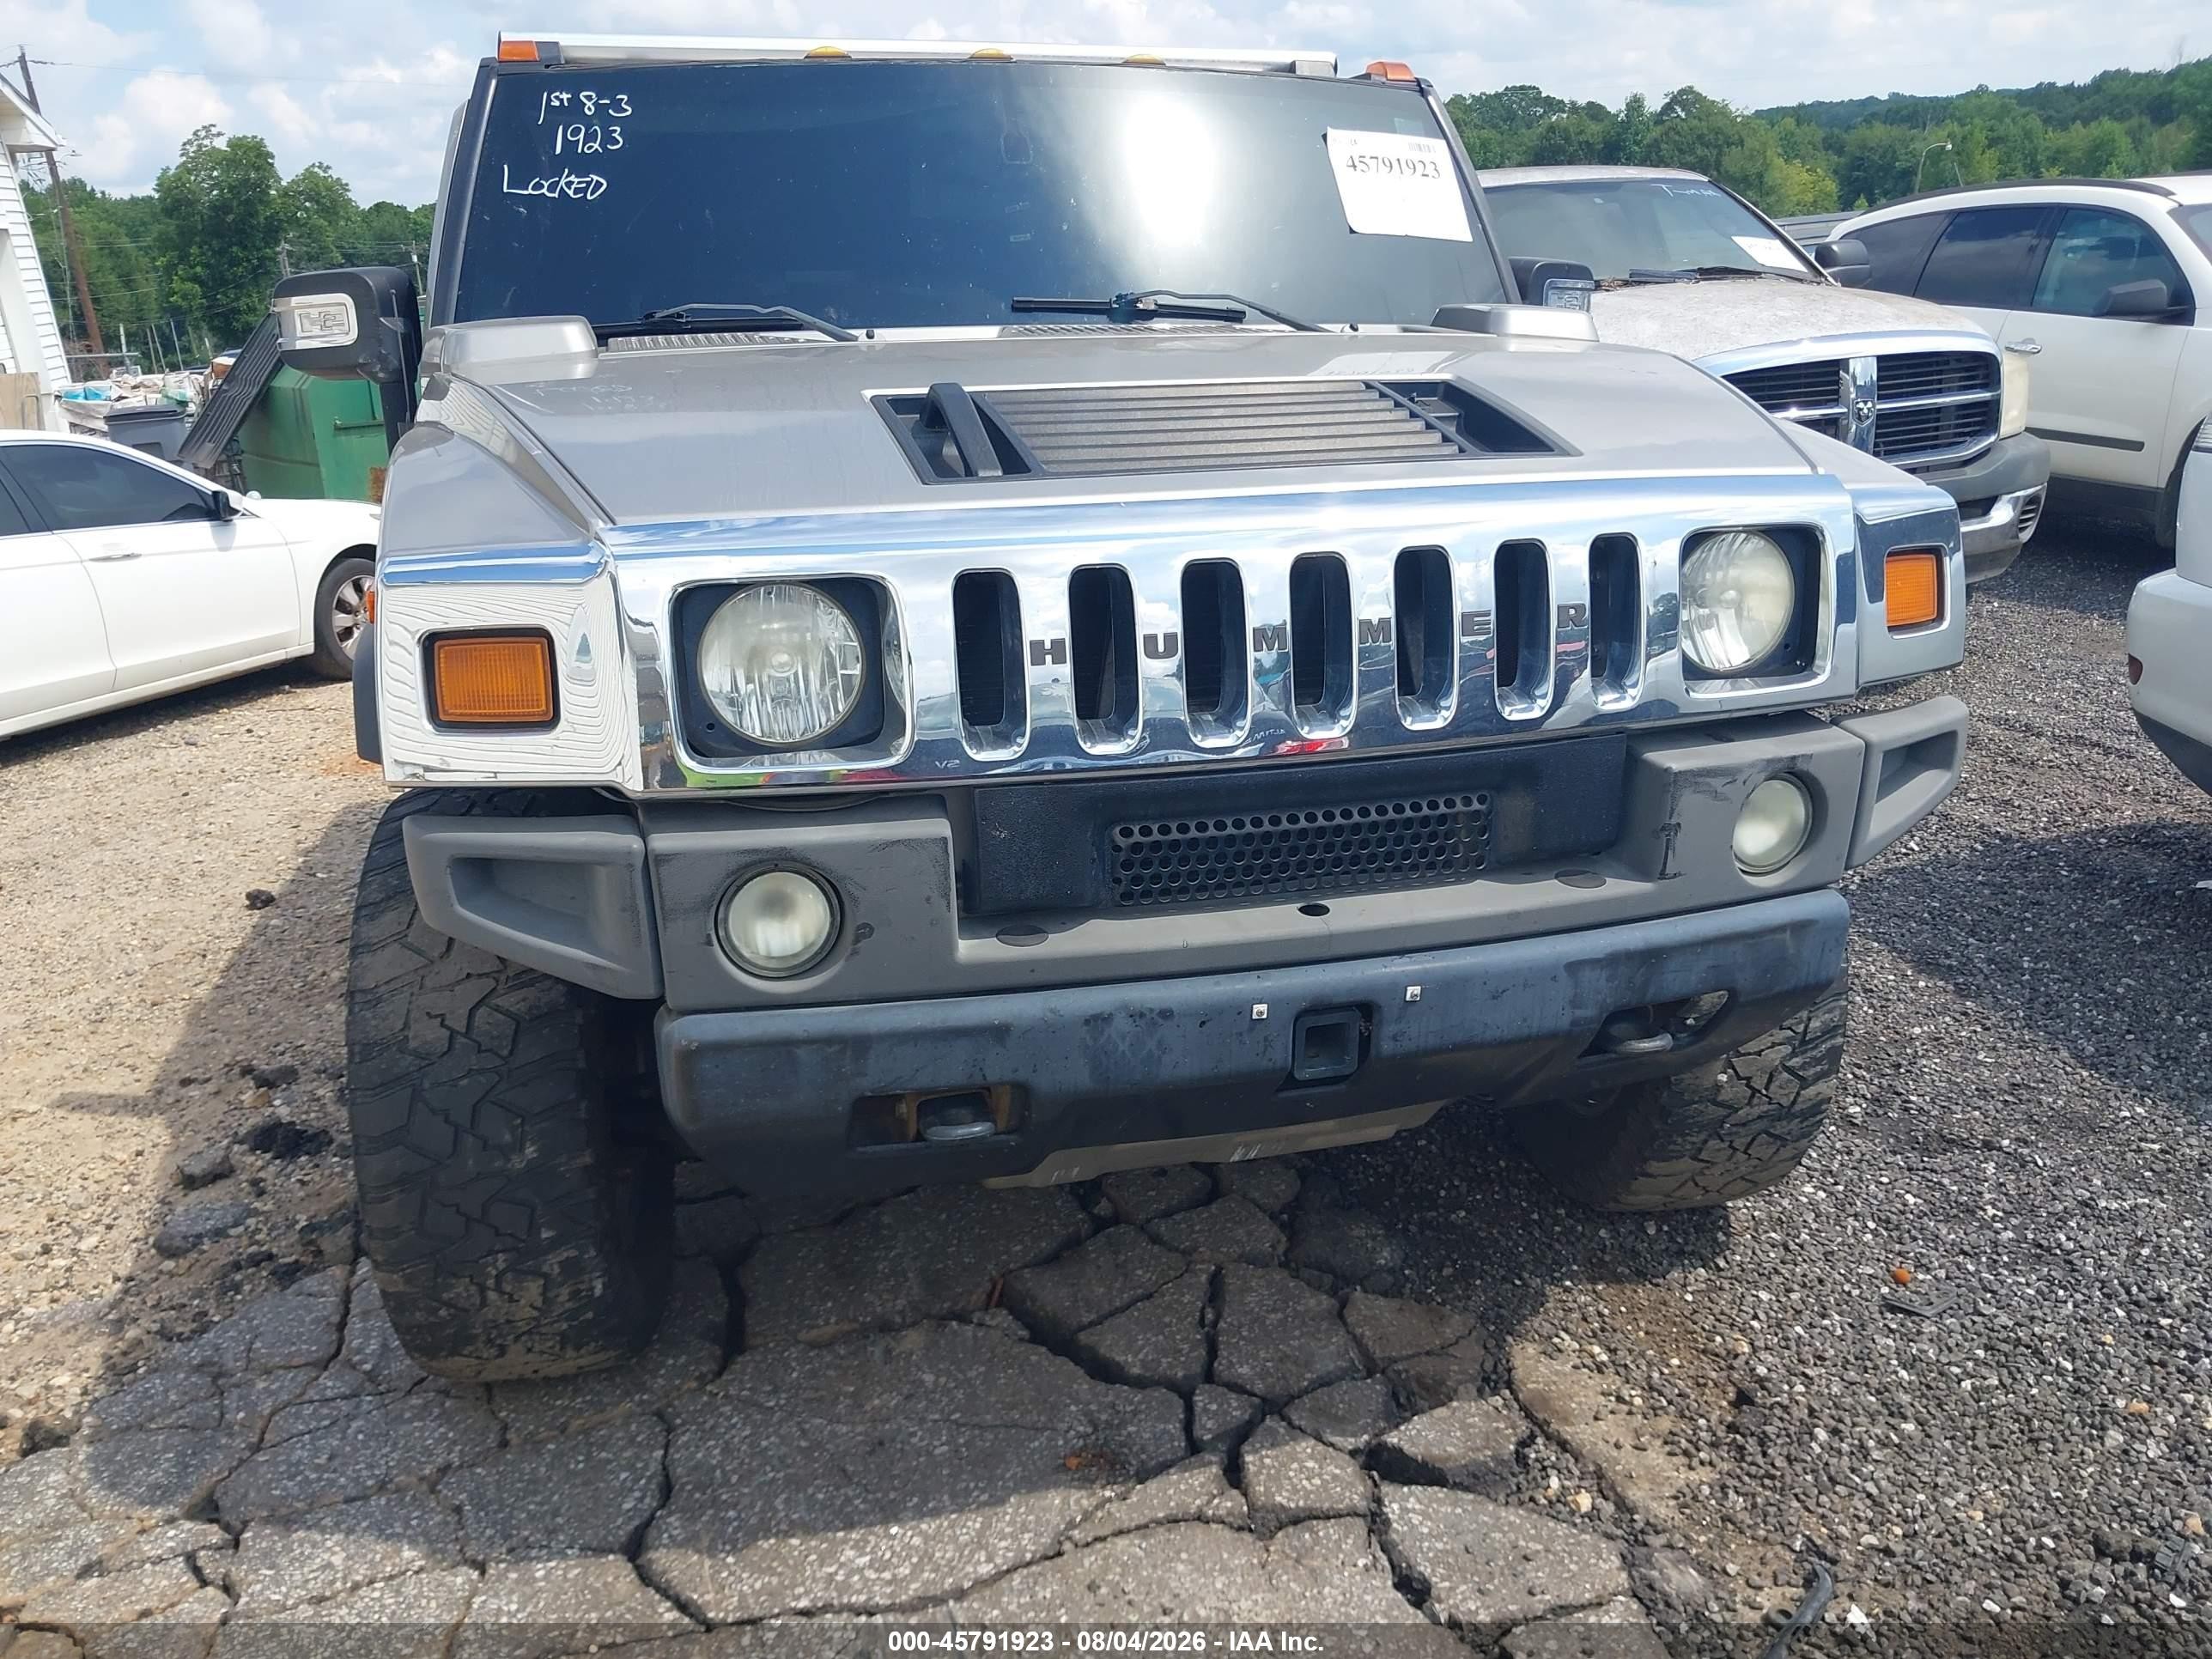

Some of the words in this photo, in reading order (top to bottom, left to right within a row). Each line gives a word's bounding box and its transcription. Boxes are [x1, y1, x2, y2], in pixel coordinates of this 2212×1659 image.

[538, 91, 572, 125] 1st
[579, 91, 633, 117] 8-3
[555, 124, 624, 155] 1923
[1346, 155, 1441, 179] 45791923
[1029, 603, 1588, 667] HUMMER
